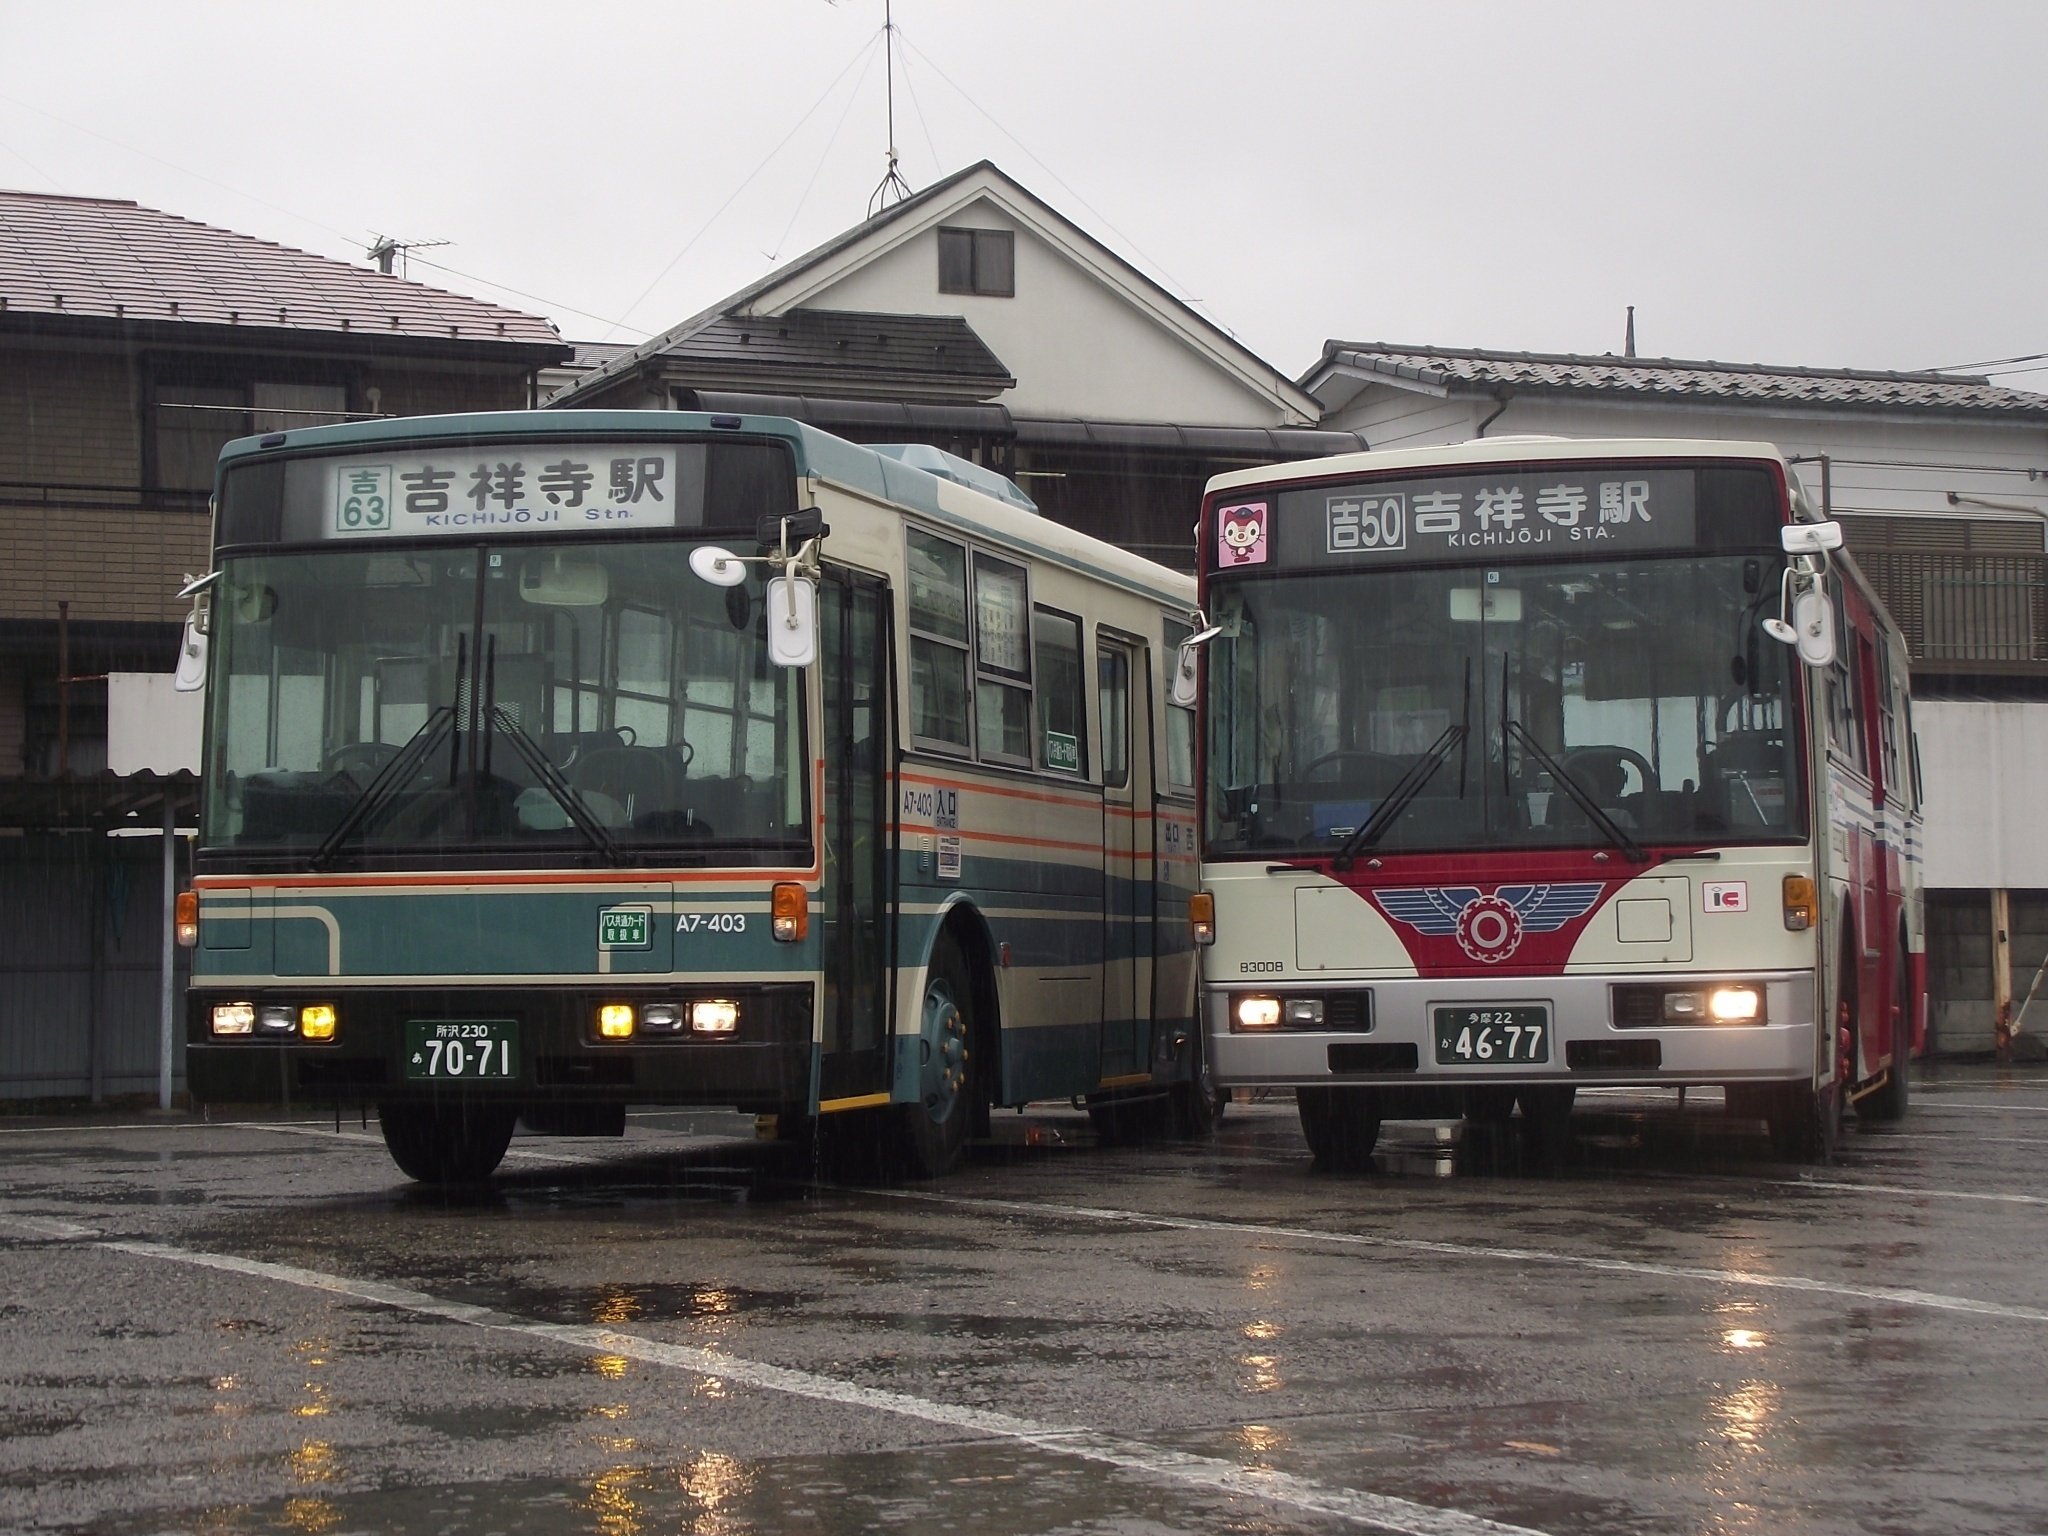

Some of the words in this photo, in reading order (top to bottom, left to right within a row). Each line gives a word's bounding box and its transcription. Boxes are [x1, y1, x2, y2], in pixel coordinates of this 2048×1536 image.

[349, 470, 381, 494] 吉
[400, 457, 665, 513] 吉祥寺駅
[344, 496, 385, 526] 63
[426, 508, 559, 526] KICHIJŌJI
[585, 508, 634, 521] Stn.
[1412, 480, 1652, 533] 吉祥寺駅
[1331, 496, 1399, 548] 吉50
[1448, 528, 1552, 547] KICHIJŌJI
[1570, 525, 1615, 541] STA.
[903, 790, 932, 817] A7-403
[936, 789, 956, 816] 入口
[602, 914, 645, 927] バス共通カード
[676, 914, 746, 933] A7-403
[607, 928, 640, 941] 取扱車
[1455, 1026, 1542, 1059] 46-77
[411, 1051, 422, 1064] あ
[425, 1040, 509, 1076] 70-71
